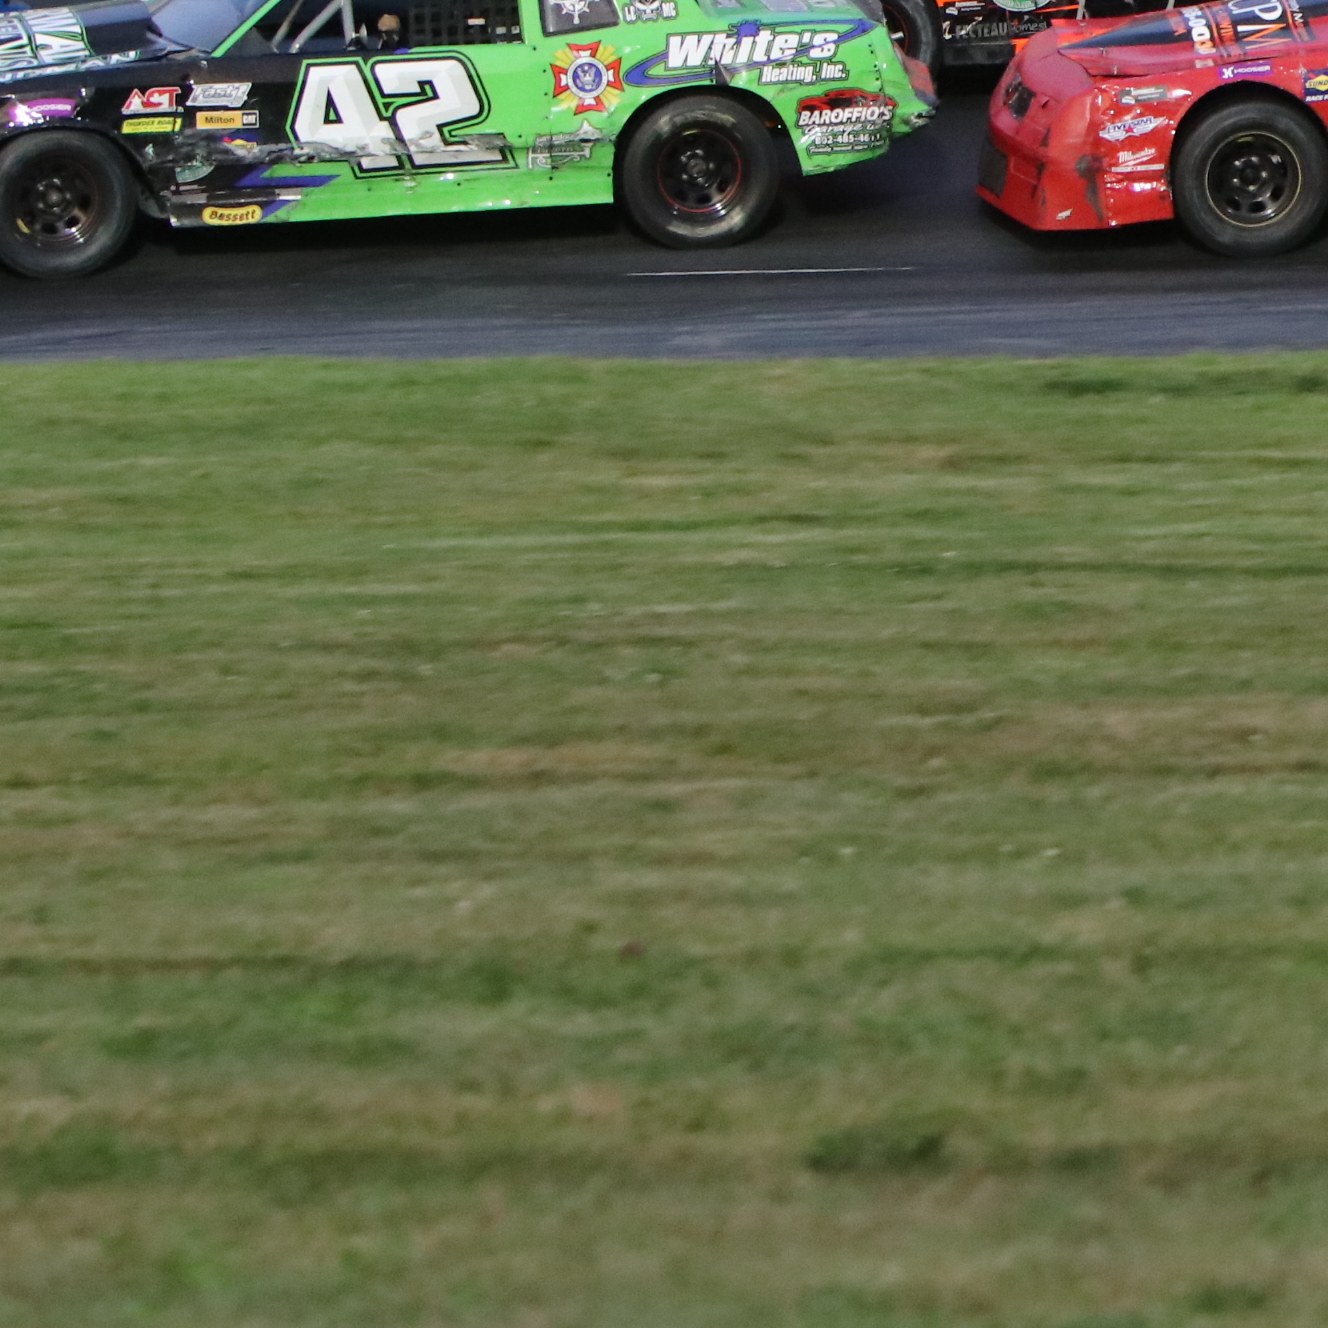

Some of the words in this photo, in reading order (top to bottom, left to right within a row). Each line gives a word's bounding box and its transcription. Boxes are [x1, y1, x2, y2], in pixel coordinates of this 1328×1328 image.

[661, 2, 677, 18] MC
[667, 30, 839, 69] White's
[761, 63, 818, 84] Heating,
[820, 61, 847, 80] Inc.
[204, 115, 235, 124] Milton
[290, 56, 487, 177] 42
[208, 209, 257, 222] Bassett
